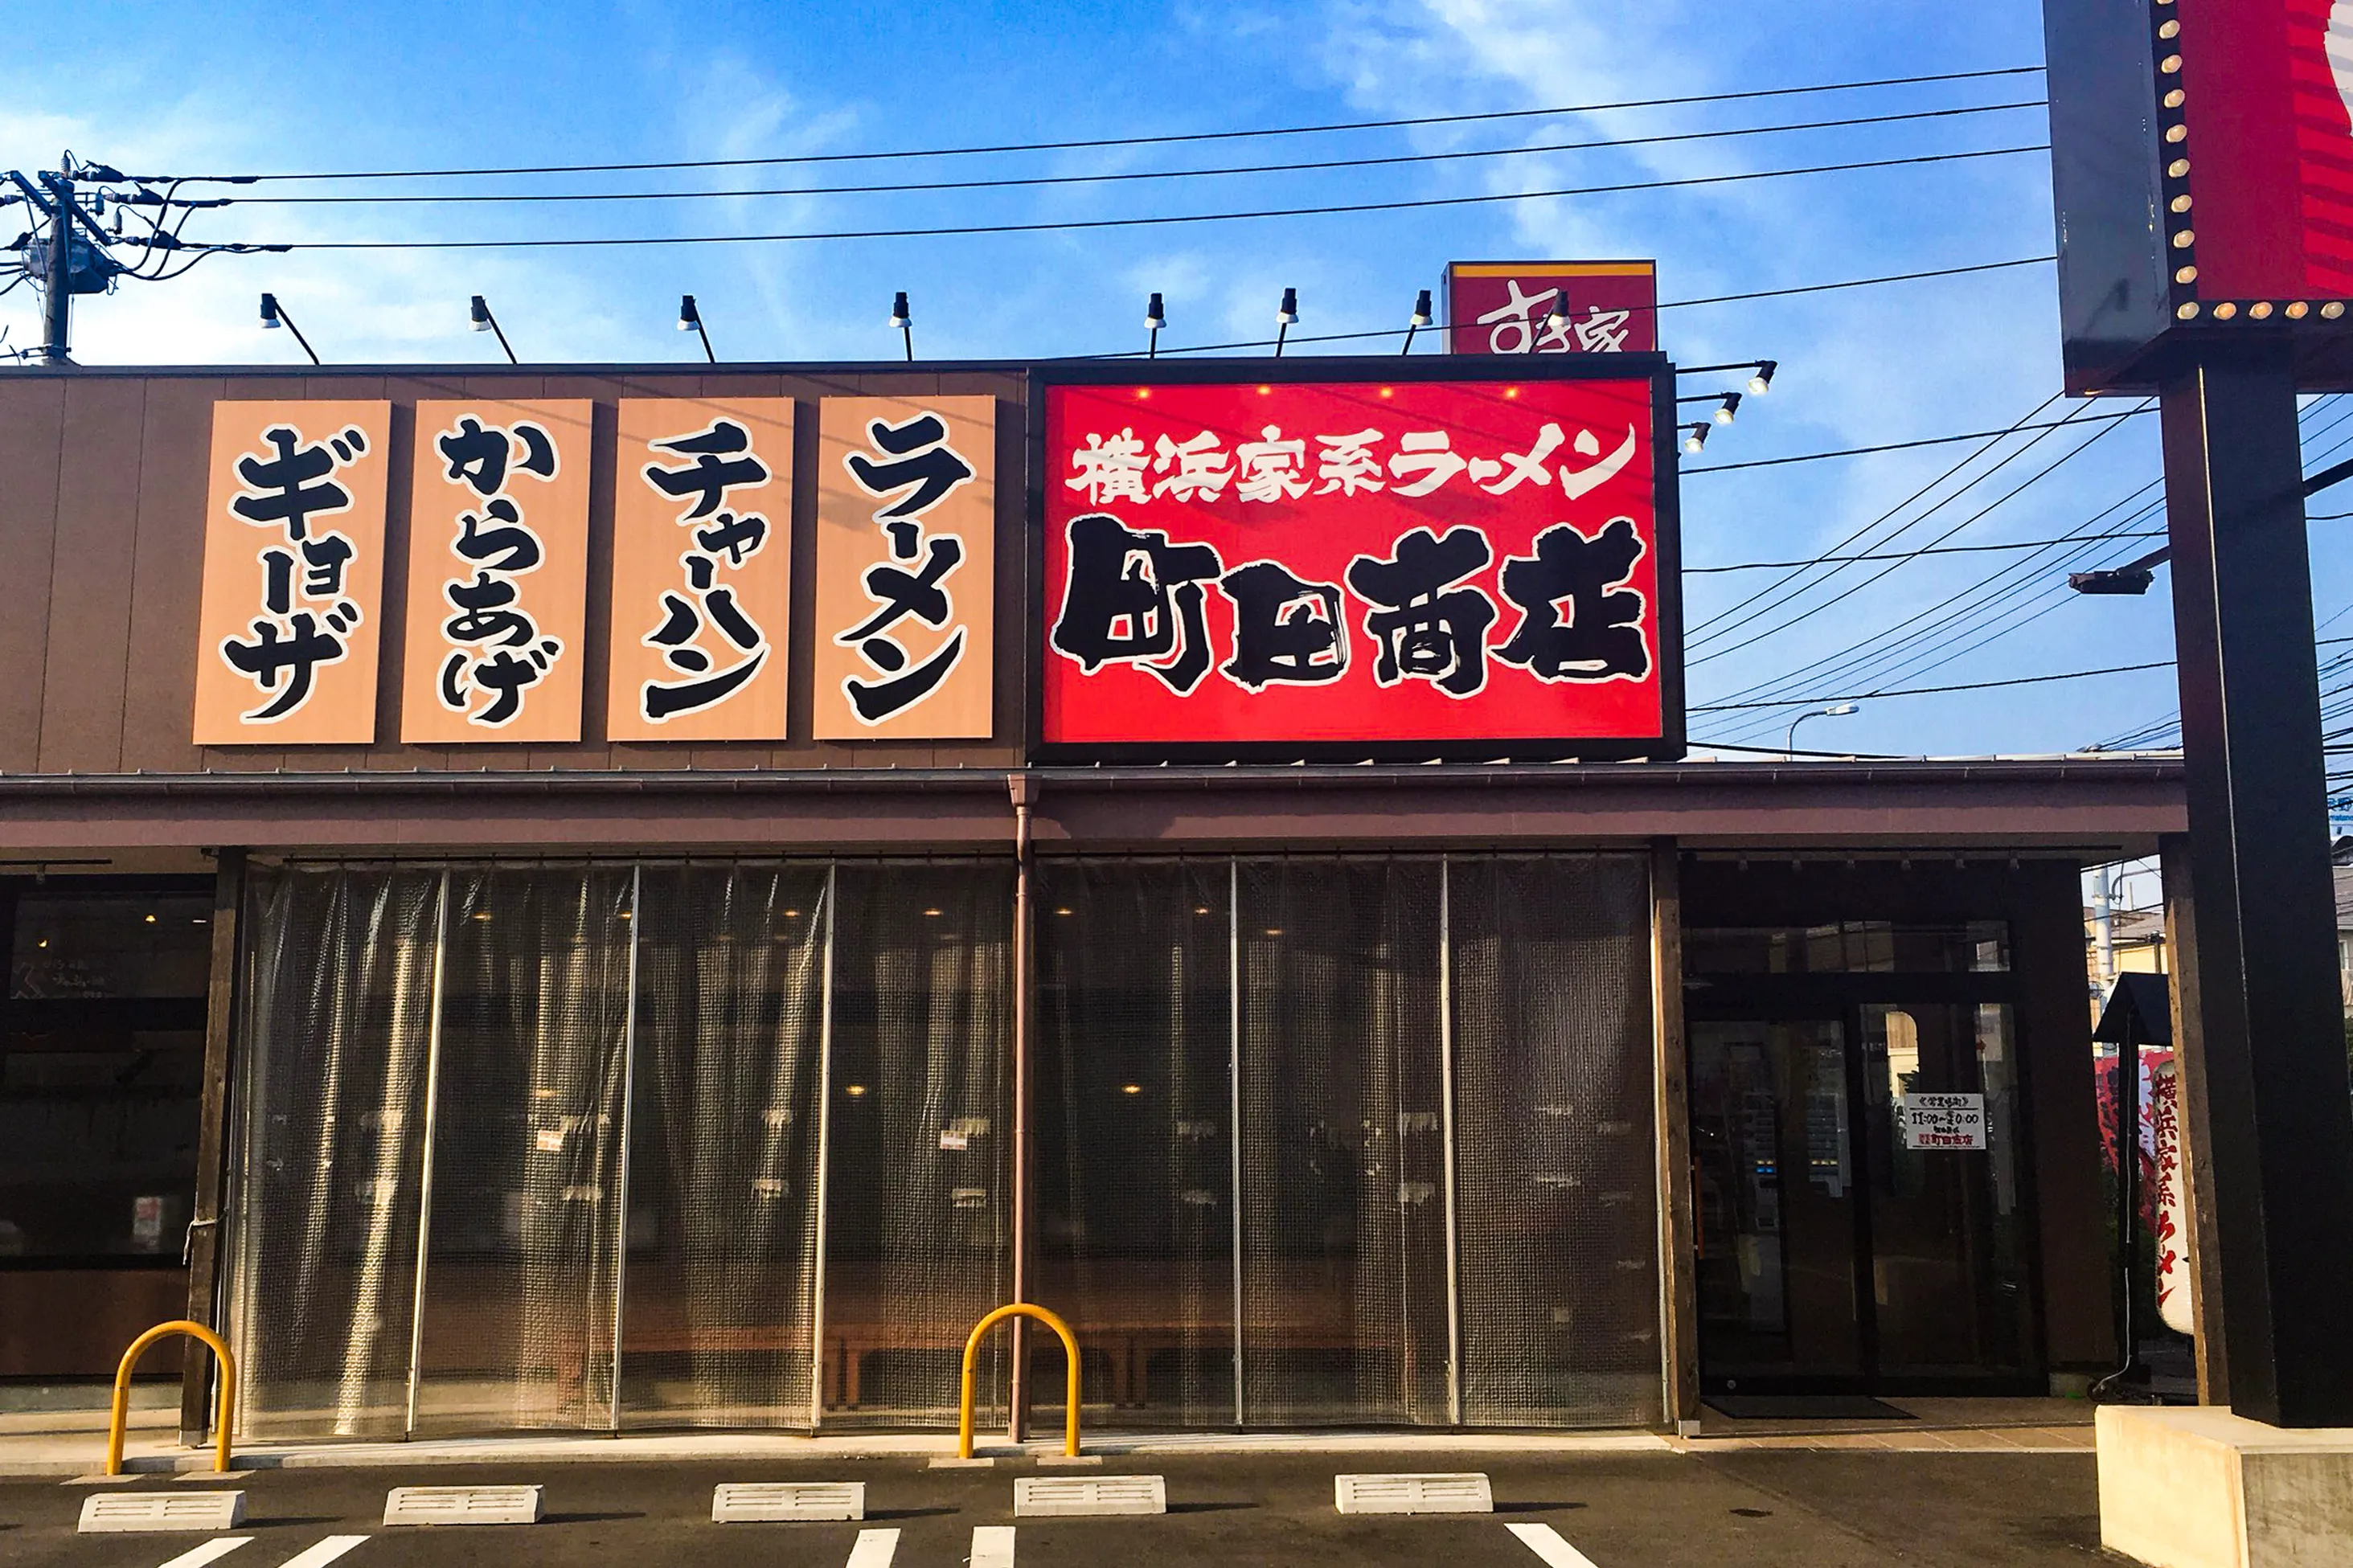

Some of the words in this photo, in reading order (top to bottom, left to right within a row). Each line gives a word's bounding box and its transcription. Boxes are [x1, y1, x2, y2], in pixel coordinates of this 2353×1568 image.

[219, 423, 371, 723] ギョーザ
[434, 412, 563, 728] からあげ
[640, 416, 772, 723] チャーハン
[834, 411, 975, 725] ラーメン
[1050, 513, 1647, 699] 町田商店
[1065, 422, 1635, 506] 横浜家系ラーメン
